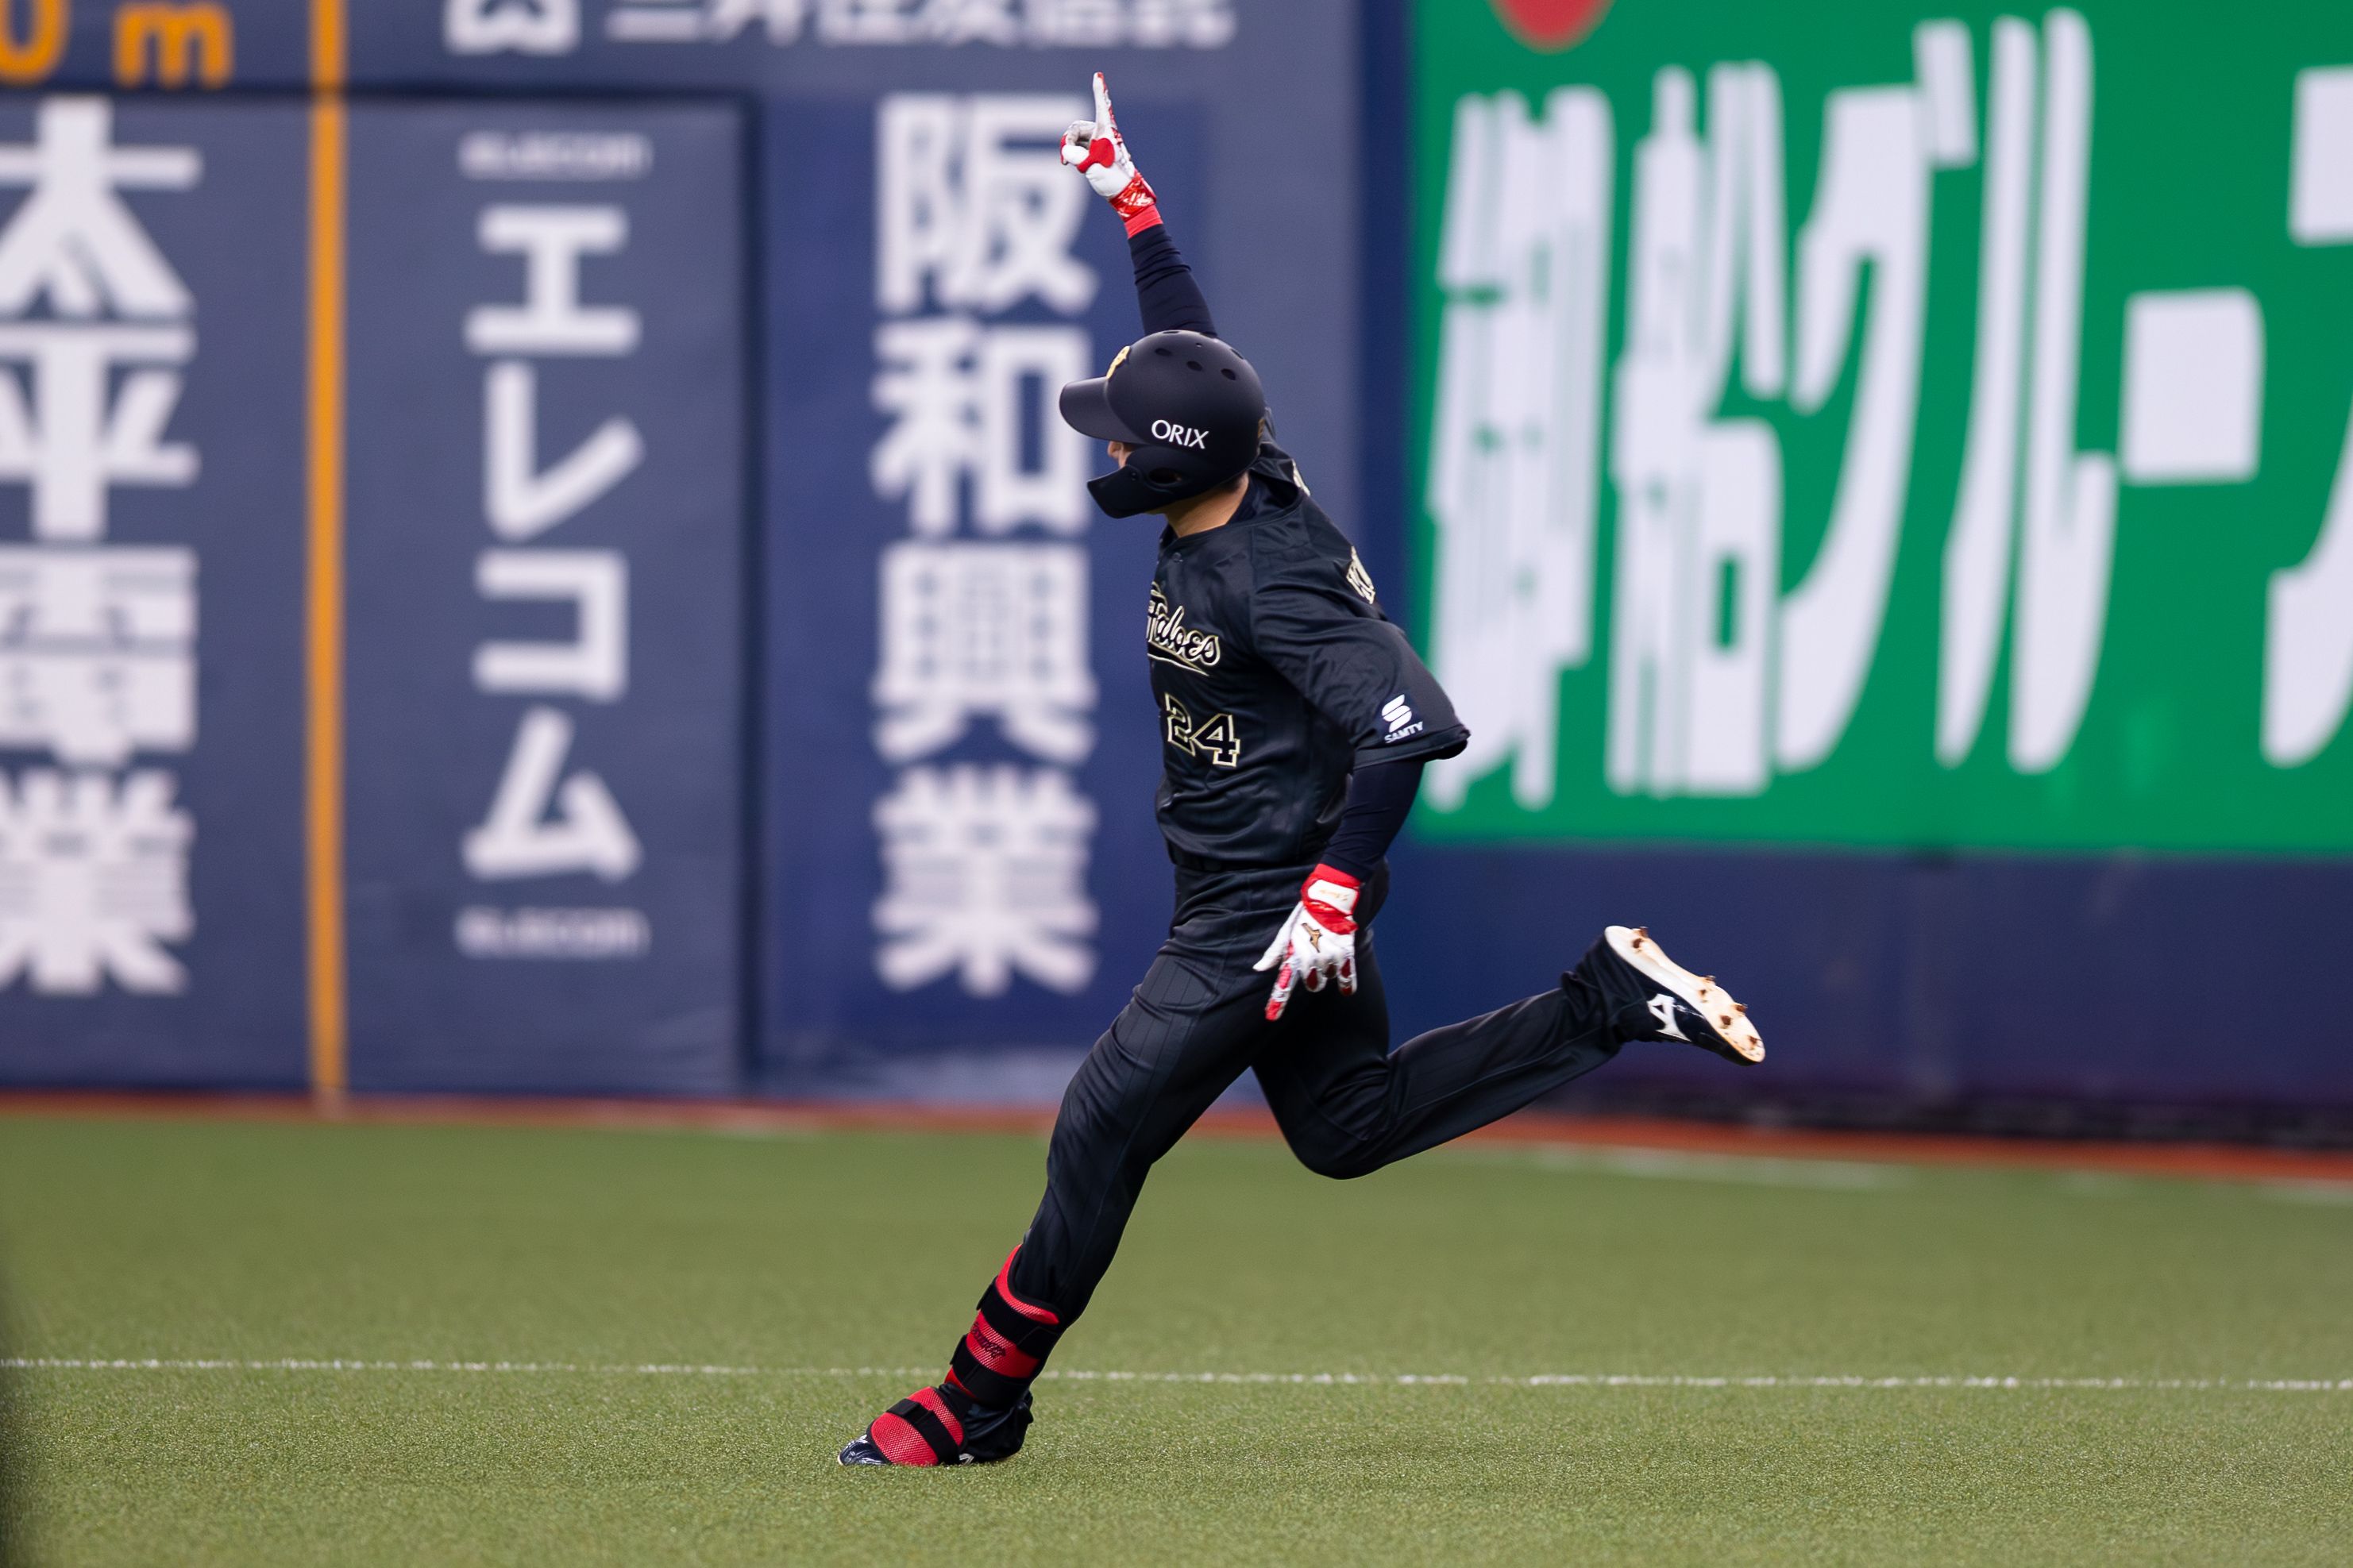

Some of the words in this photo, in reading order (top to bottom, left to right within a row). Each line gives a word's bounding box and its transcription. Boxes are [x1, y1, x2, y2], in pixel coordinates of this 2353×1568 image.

[1151, 419, 1209, 449] ORIX
[465, 205, 643, 881] エレコム
[874, 95, 1097, 995] 阪和興業
[1164, 692, 1240, 767] 24
[1384, 721, 1424, 743] SAMTY
